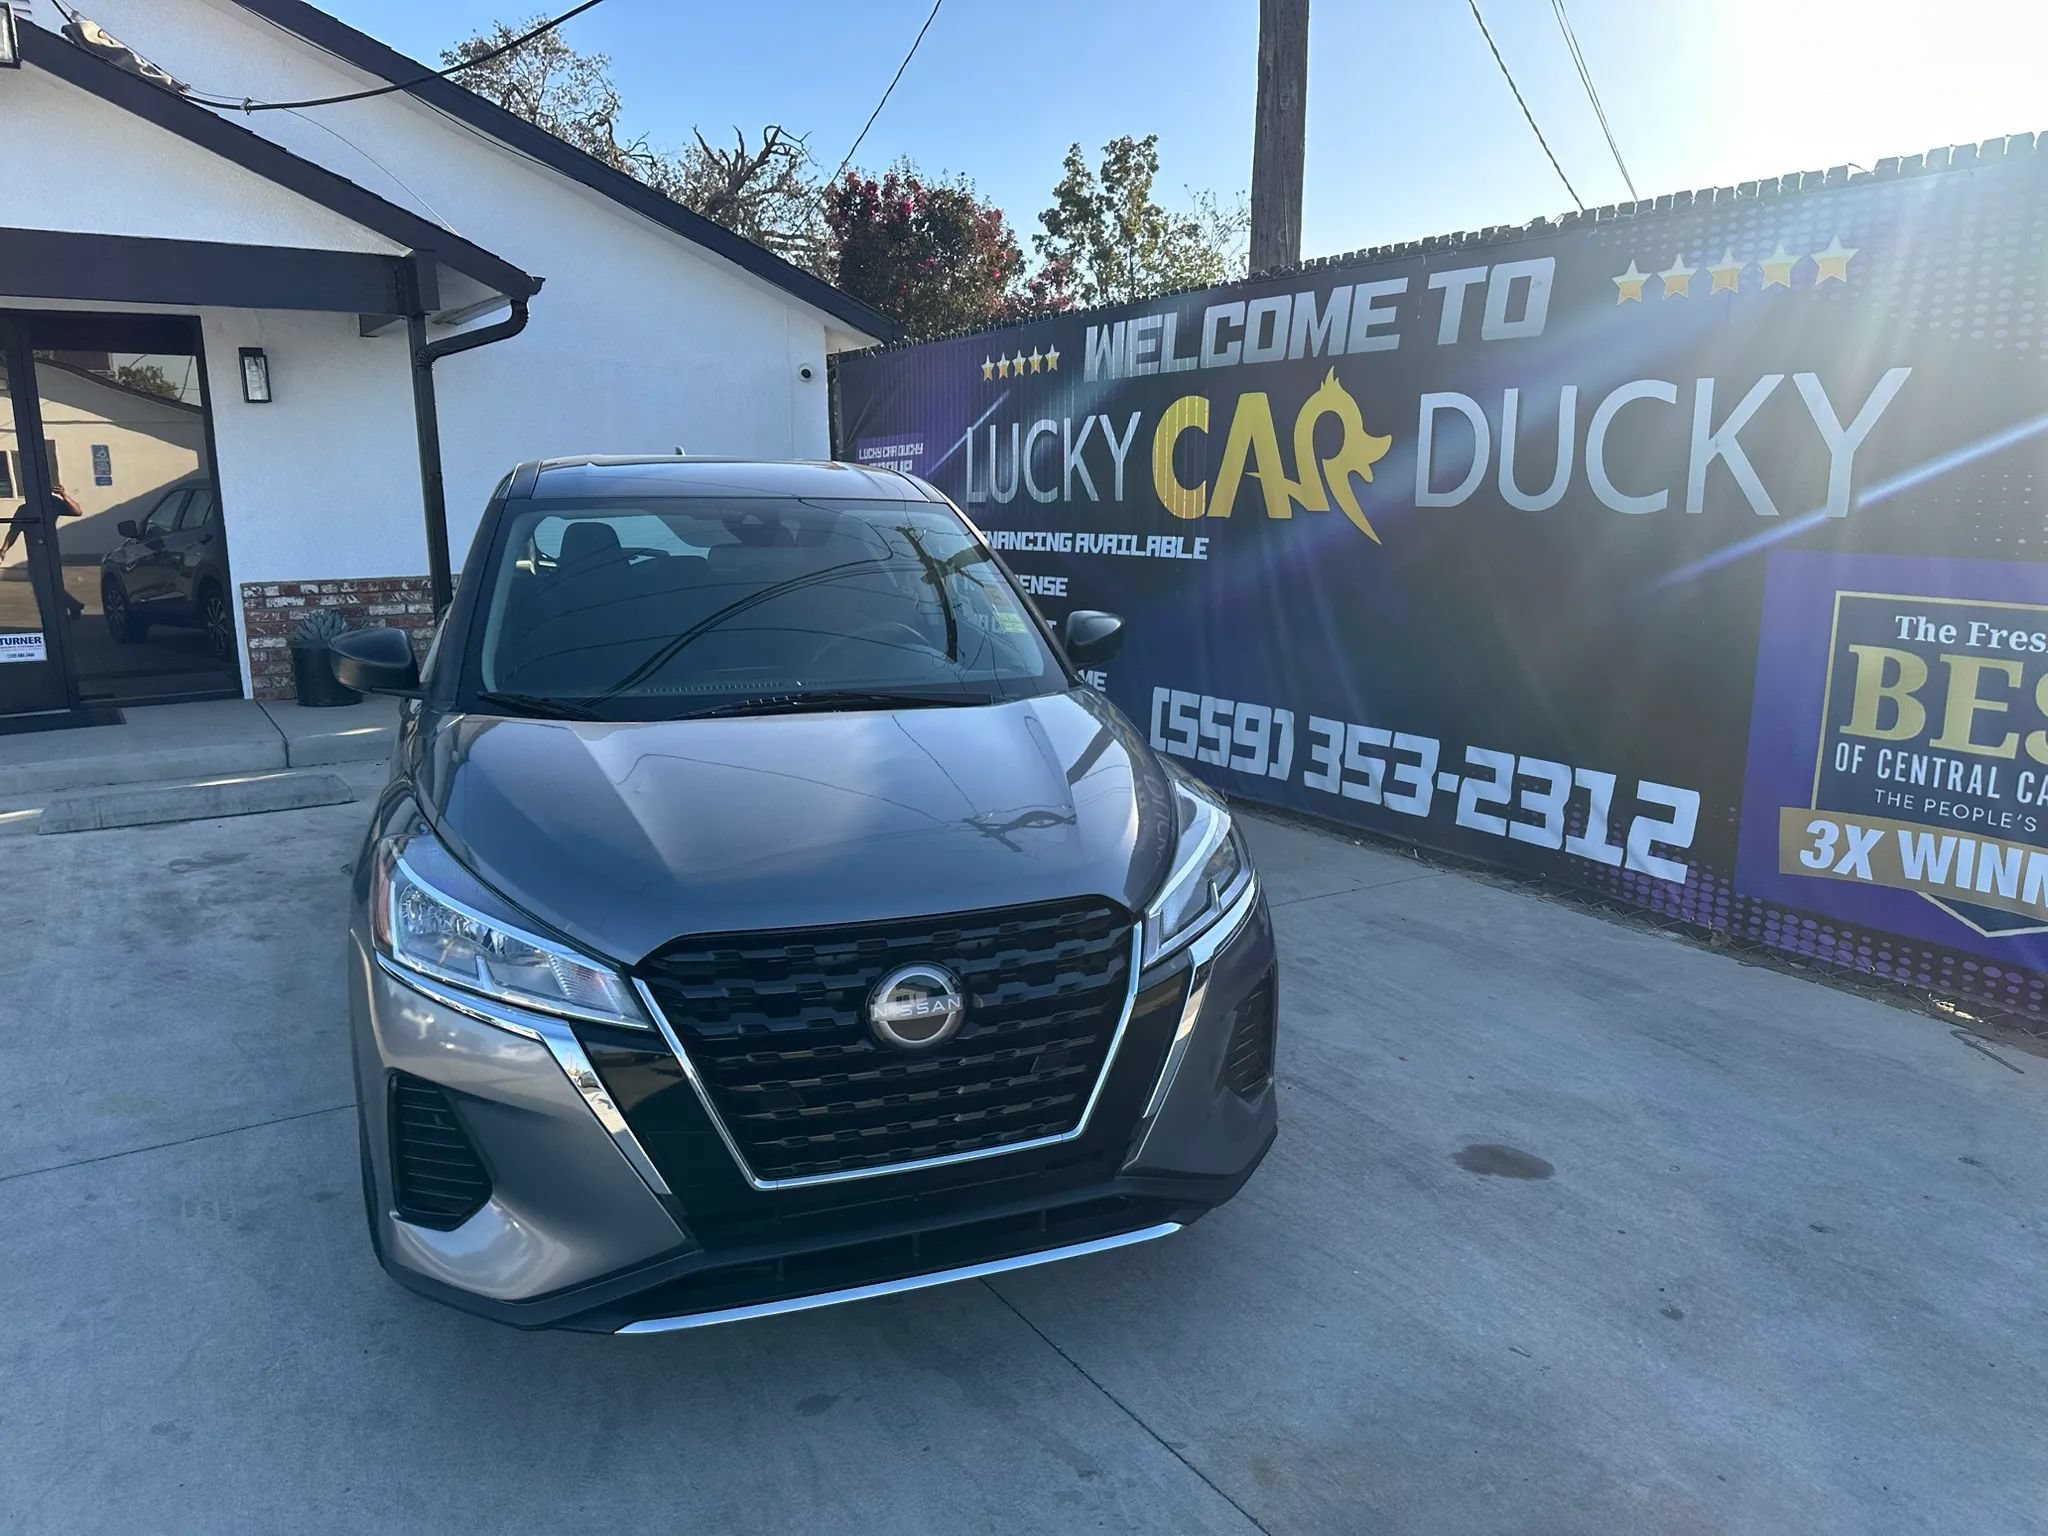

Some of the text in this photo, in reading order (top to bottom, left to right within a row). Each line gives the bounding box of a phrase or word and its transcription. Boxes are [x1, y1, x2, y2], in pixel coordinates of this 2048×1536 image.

[1083, 256, 1556, 383] WELCOME TO
[859, 442, 923, 460] LUCKY CAR DUCKY
[869, 460, 913, 473] OUP
[966, 365, 1912, 546] LUCKY CAR DUCKY
[980, 530, 1210, 561] NANCING AVAILABLE
[1015, 574, 1069, 597] ENSE
[1895, 615, 2048, 654] The Fres
[1150, 686, 1294, 781] (559)
[1303, 714, 1701, 885] 353-2312
[1835, 742, 1866, 774] OF
[1877, 748, 2001, 800] CENTRAL
[1875, 788, 2038, 833] THE PEOPLE'S
[1800, 819, 1885, 881] 3X
[874, 996, 961, 1018] NISSAN
